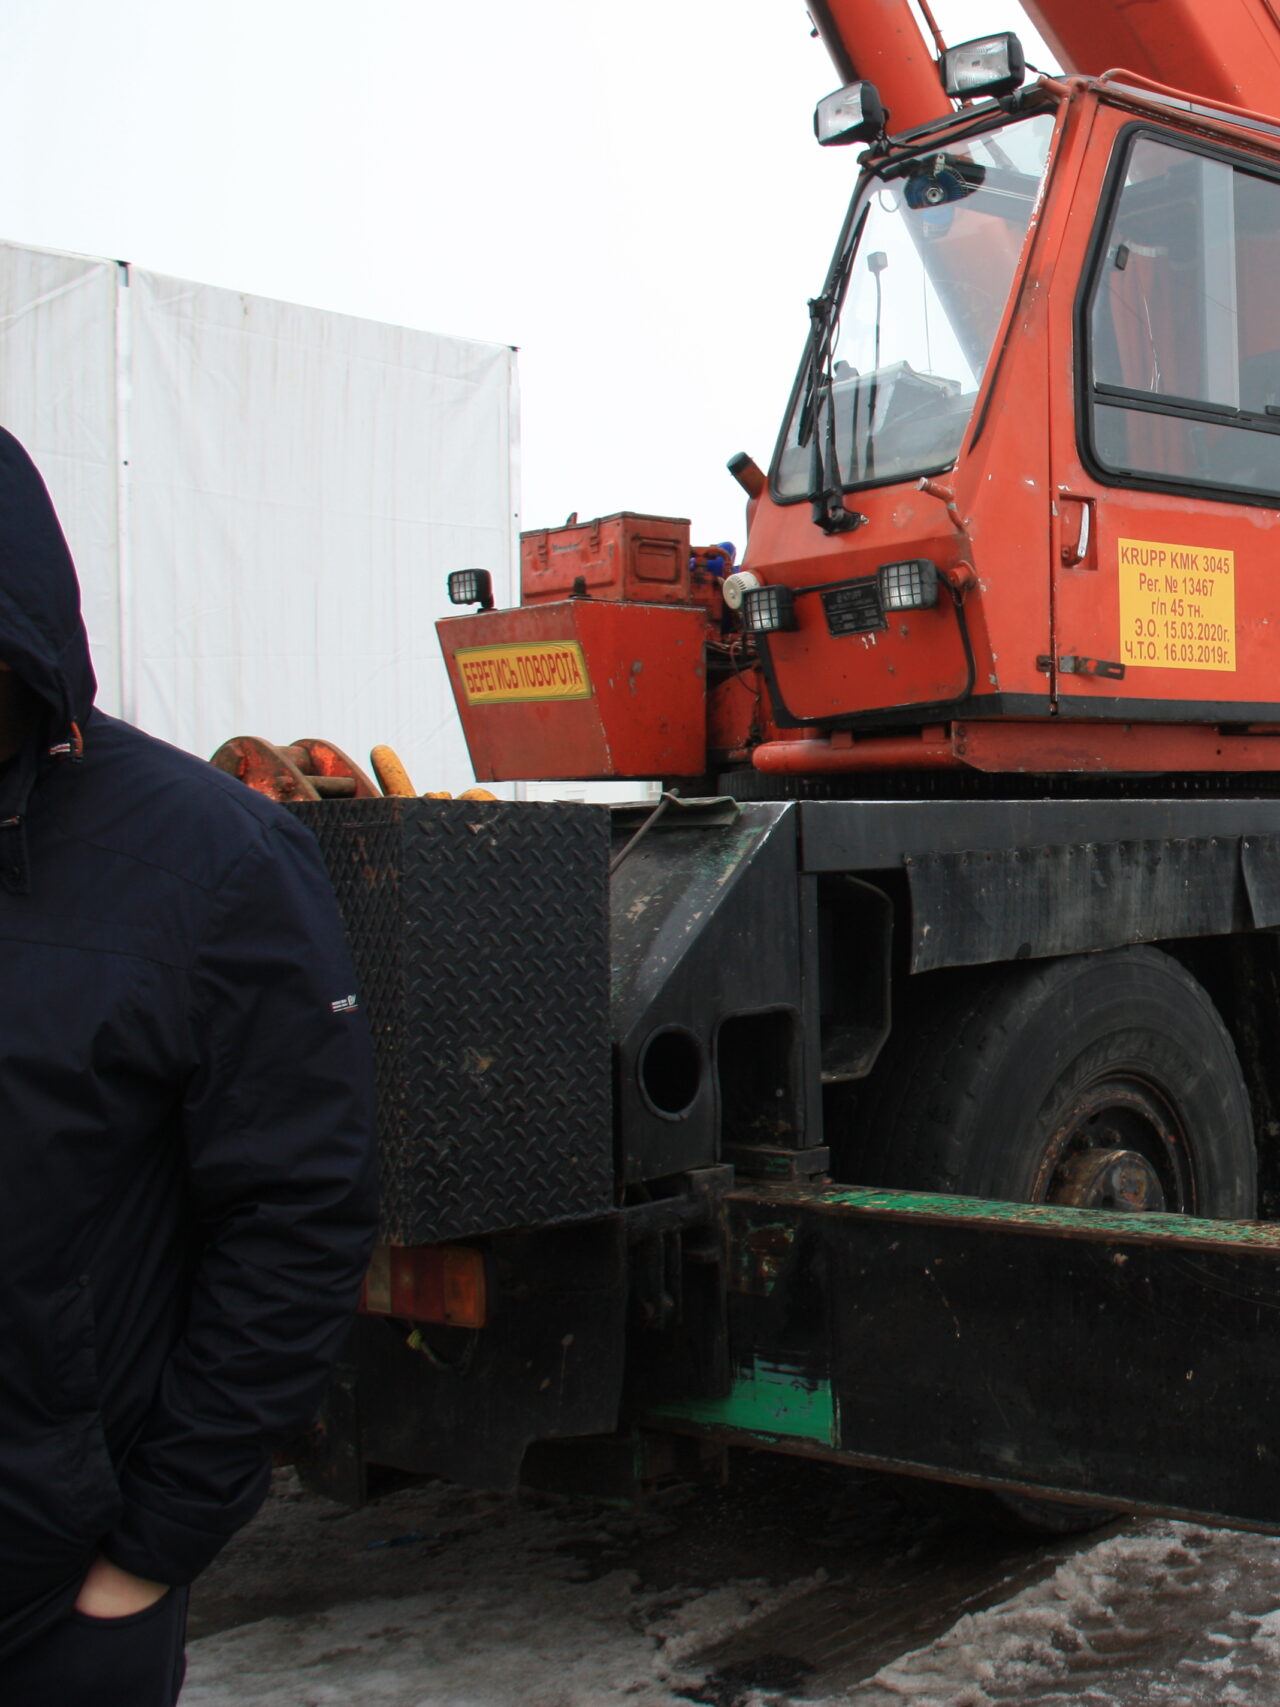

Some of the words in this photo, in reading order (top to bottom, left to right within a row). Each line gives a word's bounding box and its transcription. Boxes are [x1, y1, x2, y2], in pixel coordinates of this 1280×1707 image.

[1121, 546, 1167, 568] KRUPP
[1170, 551, 1200, 571] KMK
[1203, 555, 1230, 575] 3045
[1139, 572, 1161, 592] Рег.
[1165, 575, 1178, 593] №
[1182, 576, 1215, 597] 13467
[1151, 597, 1167, 616] г/п
[1170, 598, 1184, 617] 45
[1187, 604, 1204, 618] тн.
[1134, 618, 1160, 638] Э.О.
[1164, 620, 1230, 643] 15.03.2020г.
[1125, 640, 1160, 661] Ч.Т.О.
[1164, 643, 1230, 665] 16.03.2019г.
[462, 657, 519, 693] БЕРЕГИСЬ
[516, 651, 584, 689] ПОВОРОТА
